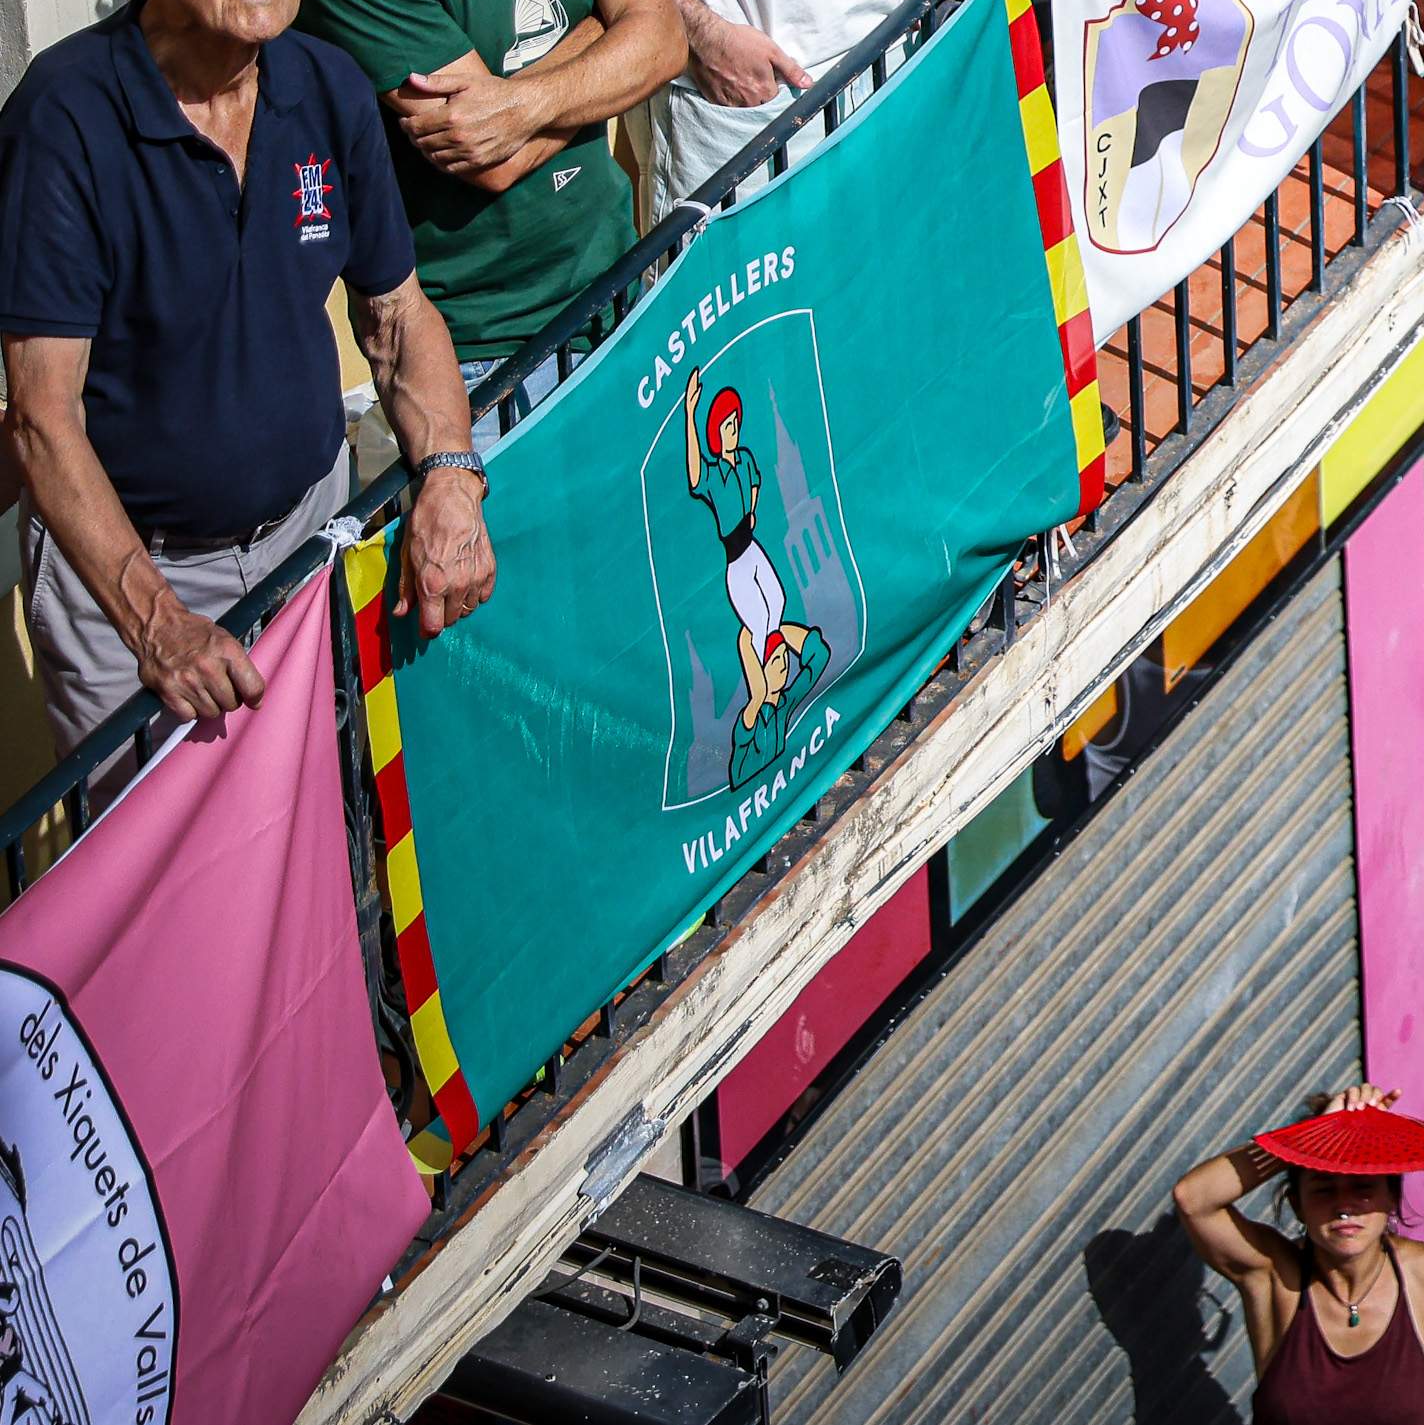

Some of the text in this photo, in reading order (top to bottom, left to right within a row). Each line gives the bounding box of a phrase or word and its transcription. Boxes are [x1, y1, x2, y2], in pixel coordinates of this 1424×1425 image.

[301, 164, 322, 189] FM
[637, 246, 796, 409] CASTELLERS
[682, 706, 841, 874] VILAFRANCA
[19, 999, 169, 1425] dels Xiquets de Valls
